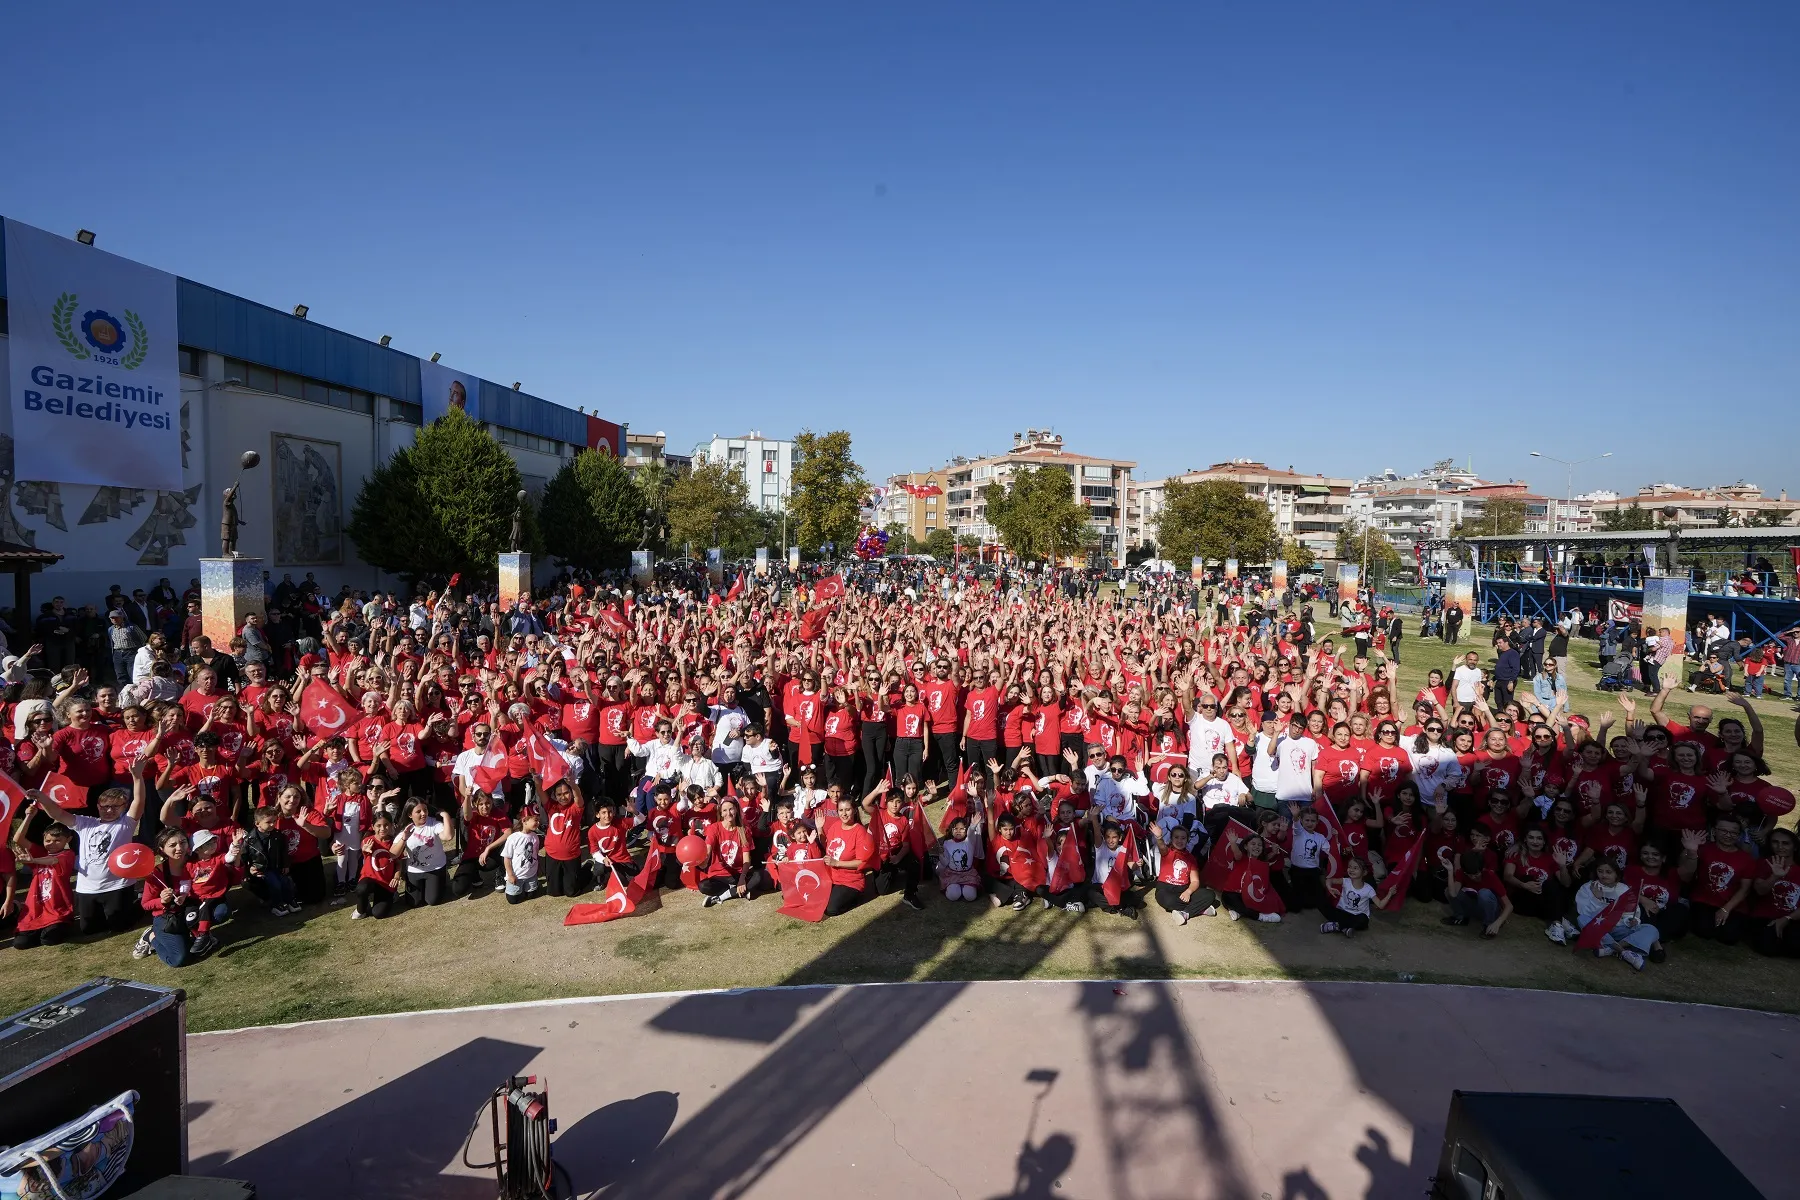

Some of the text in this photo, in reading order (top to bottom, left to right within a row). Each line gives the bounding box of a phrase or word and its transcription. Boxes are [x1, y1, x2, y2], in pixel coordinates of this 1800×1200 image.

[94, 354, 119, 366] 1926
[31, 365, 164, 406] Gaziemir
[24, 389, 171, 430] Belediyesi
